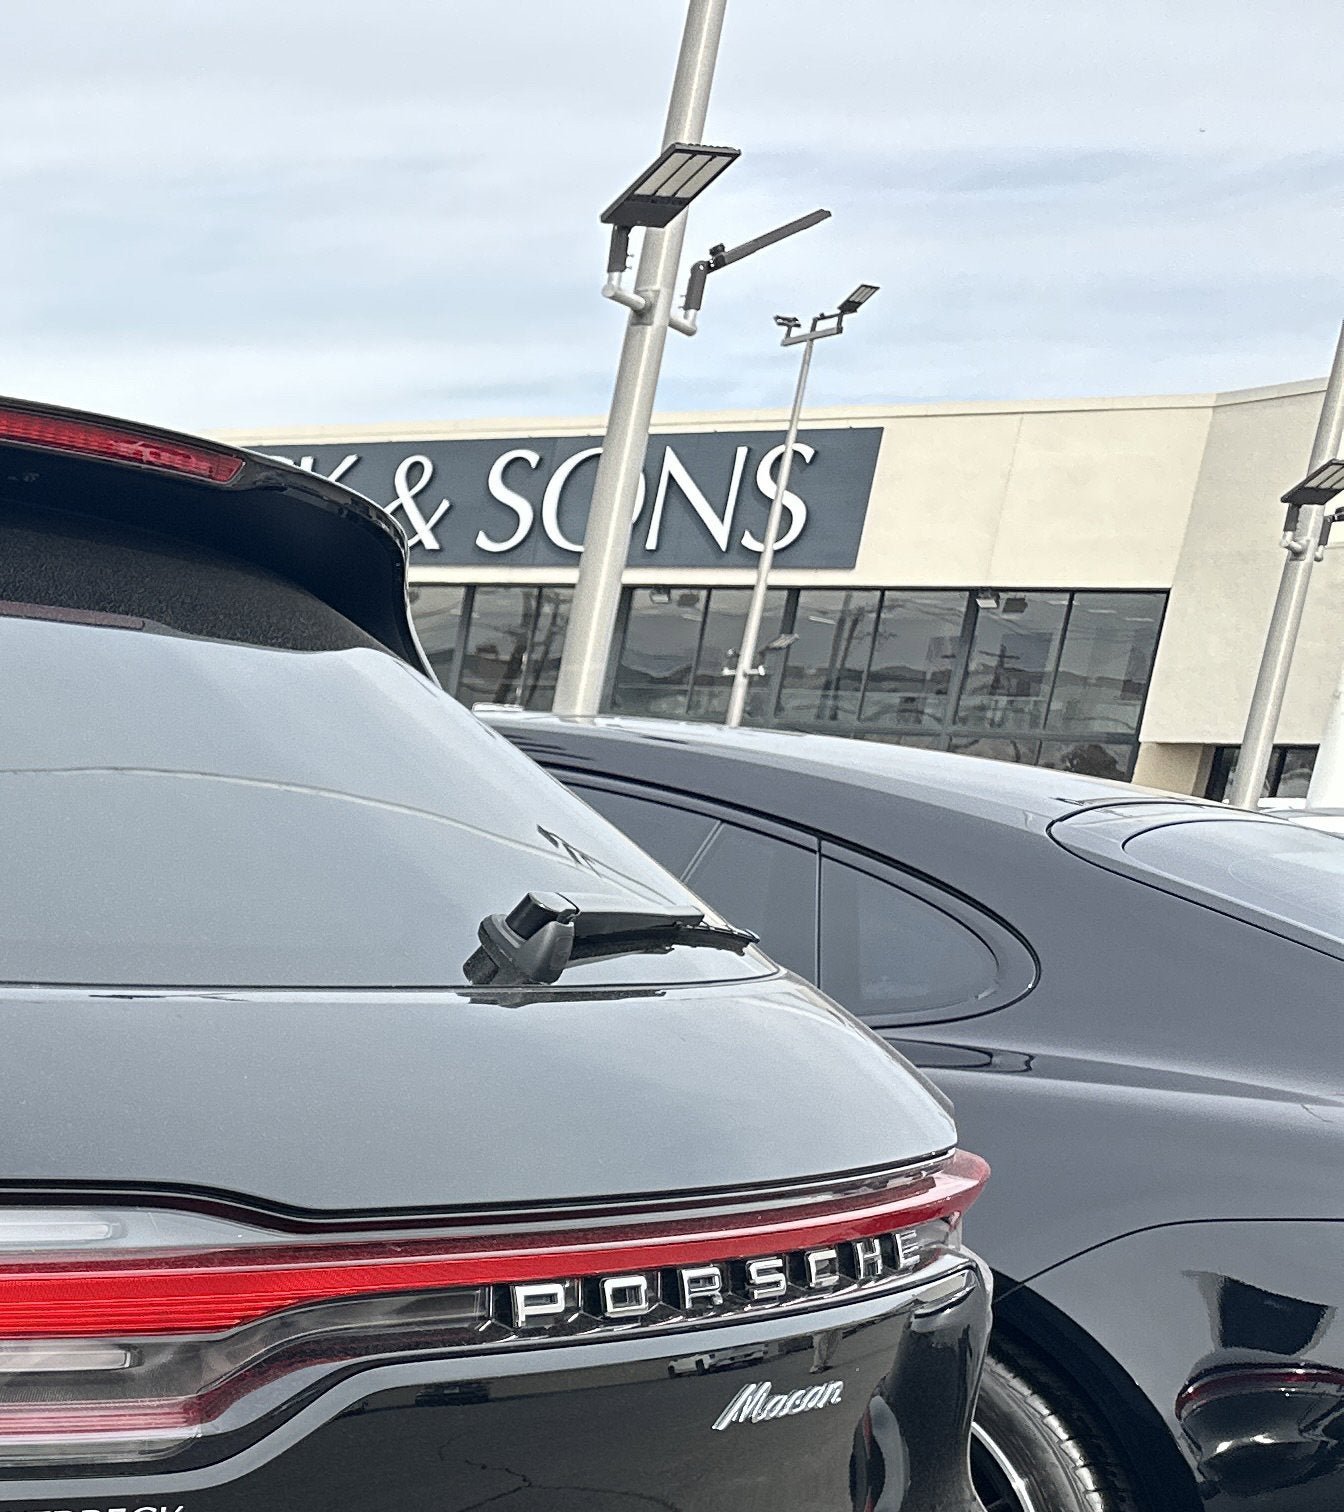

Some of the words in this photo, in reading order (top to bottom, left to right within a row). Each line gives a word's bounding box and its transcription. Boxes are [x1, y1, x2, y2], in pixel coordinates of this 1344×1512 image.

[475, 442, 816, 552] SONS
[514, 1229, 921, 1328] PORSCHE
[711, 1380, 844, 1431] Macan
